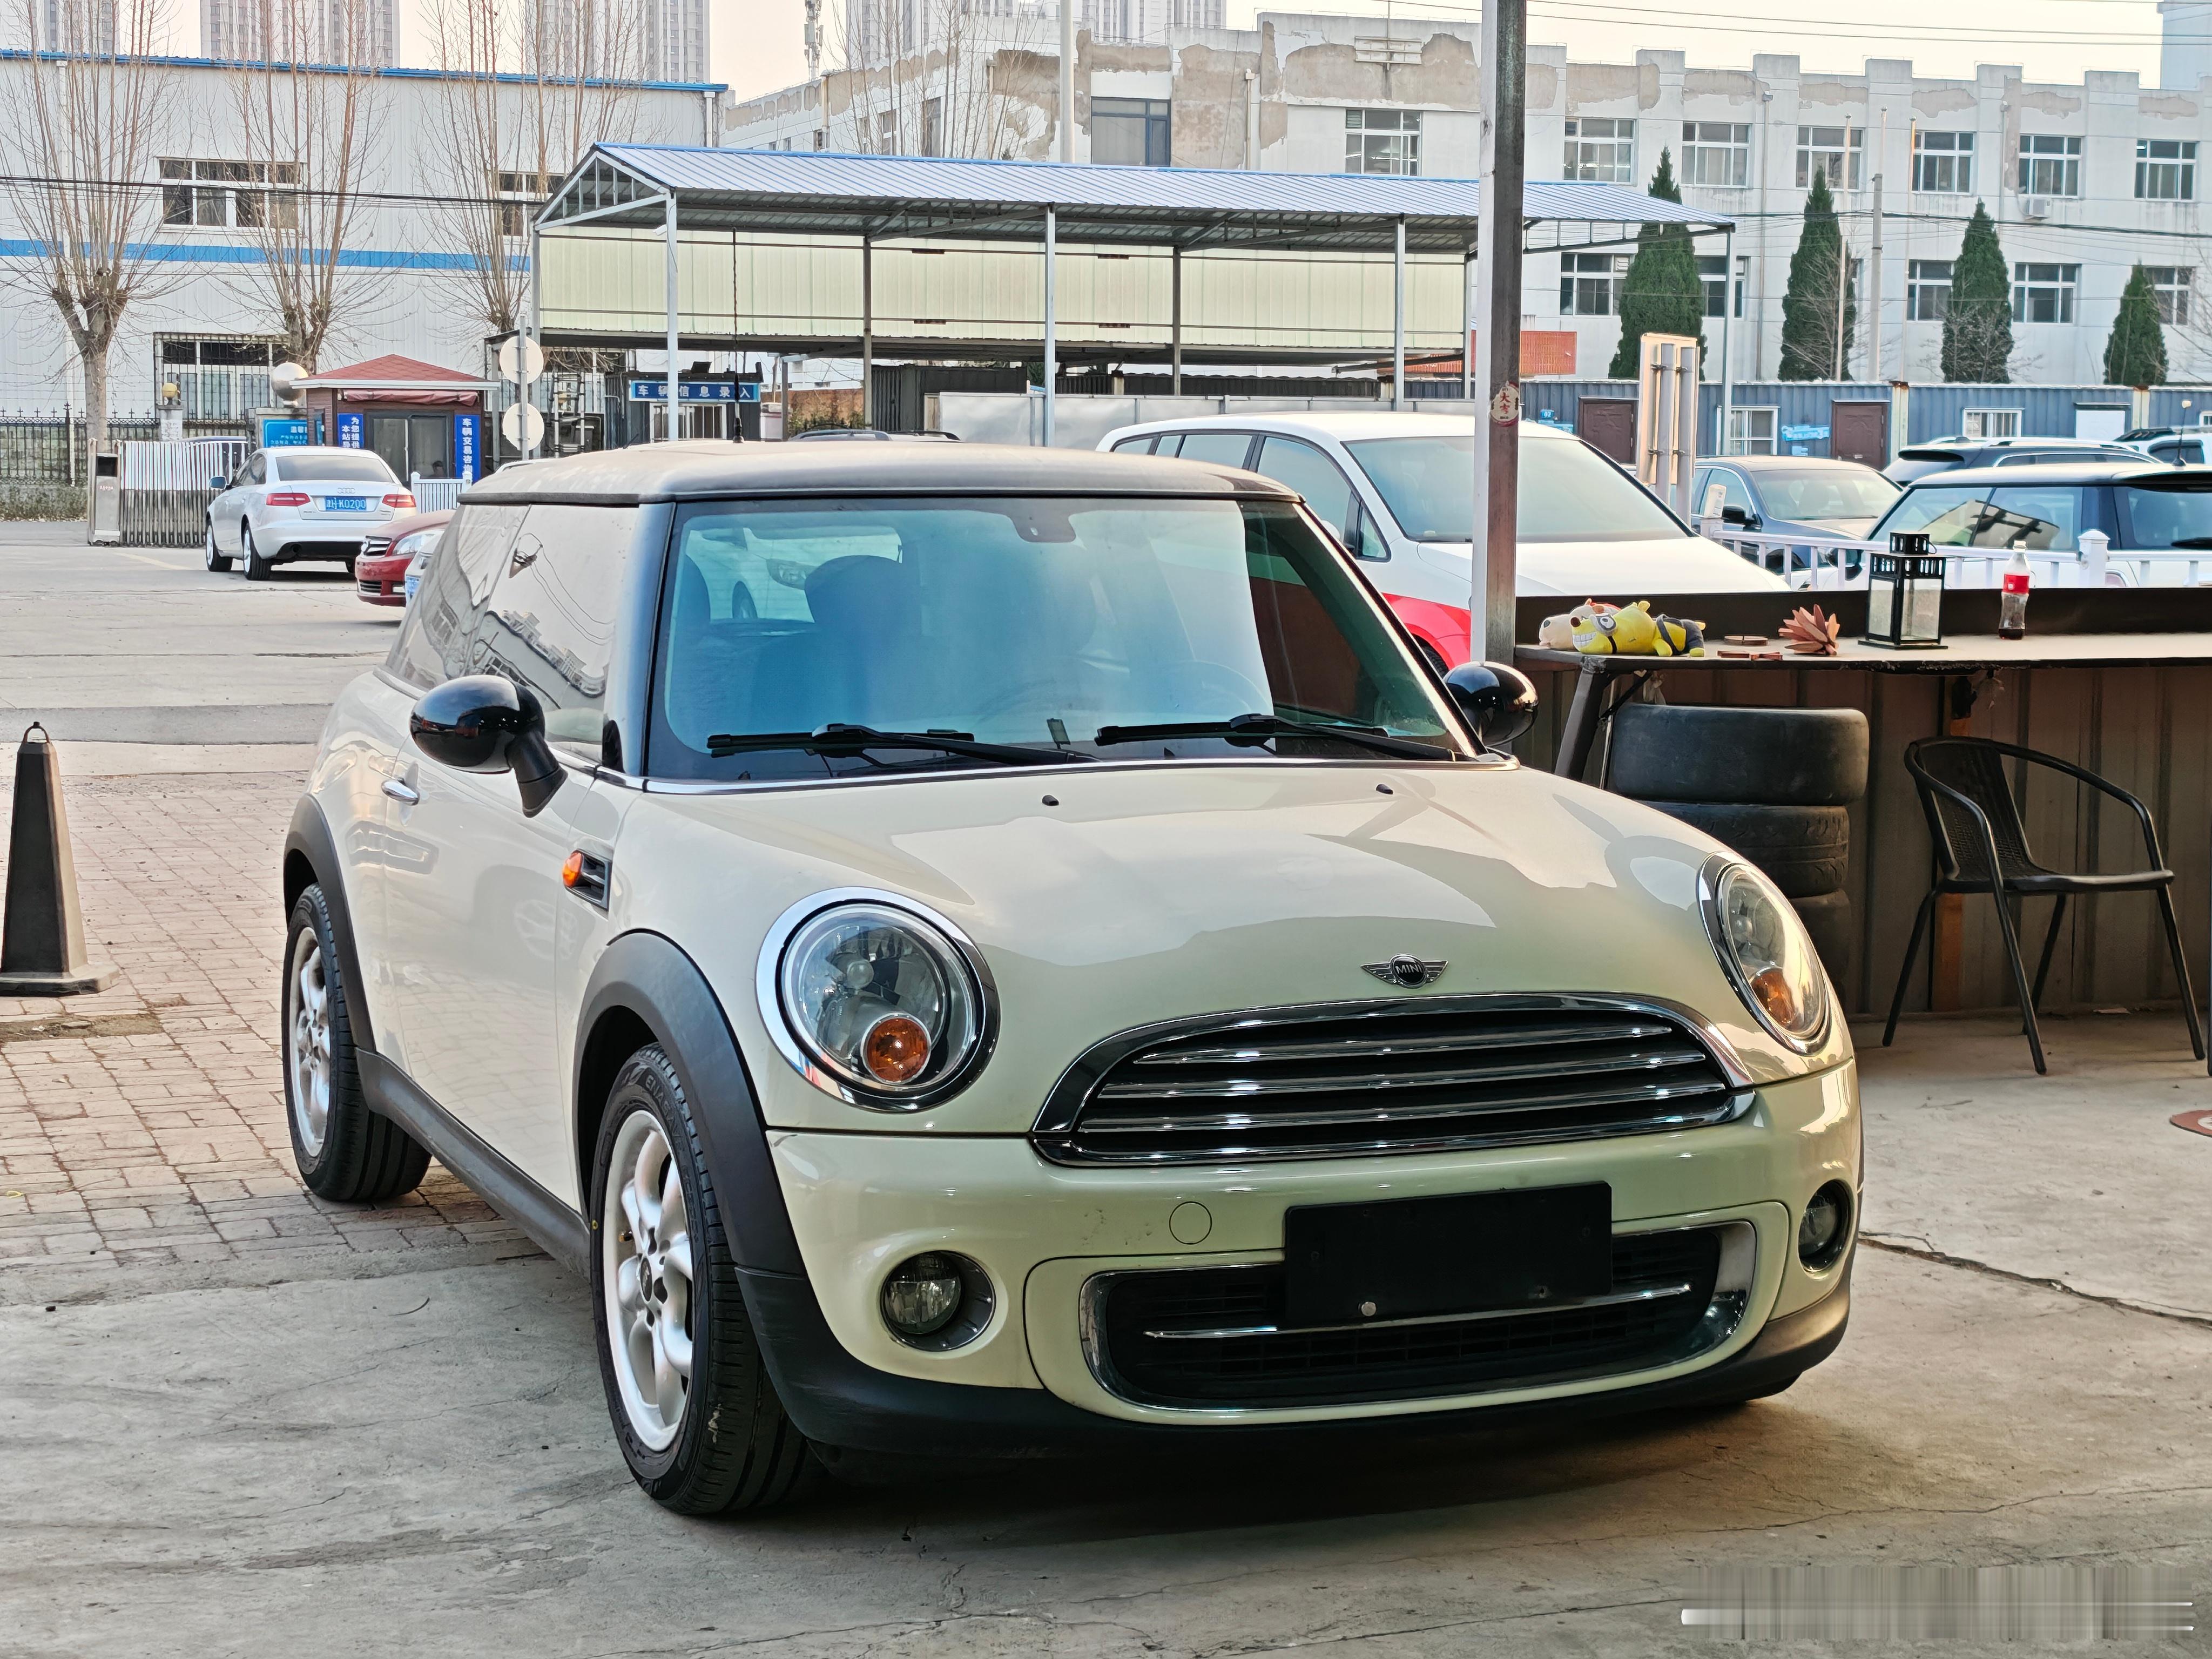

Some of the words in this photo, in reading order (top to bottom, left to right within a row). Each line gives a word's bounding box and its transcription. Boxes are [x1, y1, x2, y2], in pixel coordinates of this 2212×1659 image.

[638, 385, 751, 398] 车辆信息录入
[1395, 964, 1423, 974] MINI
